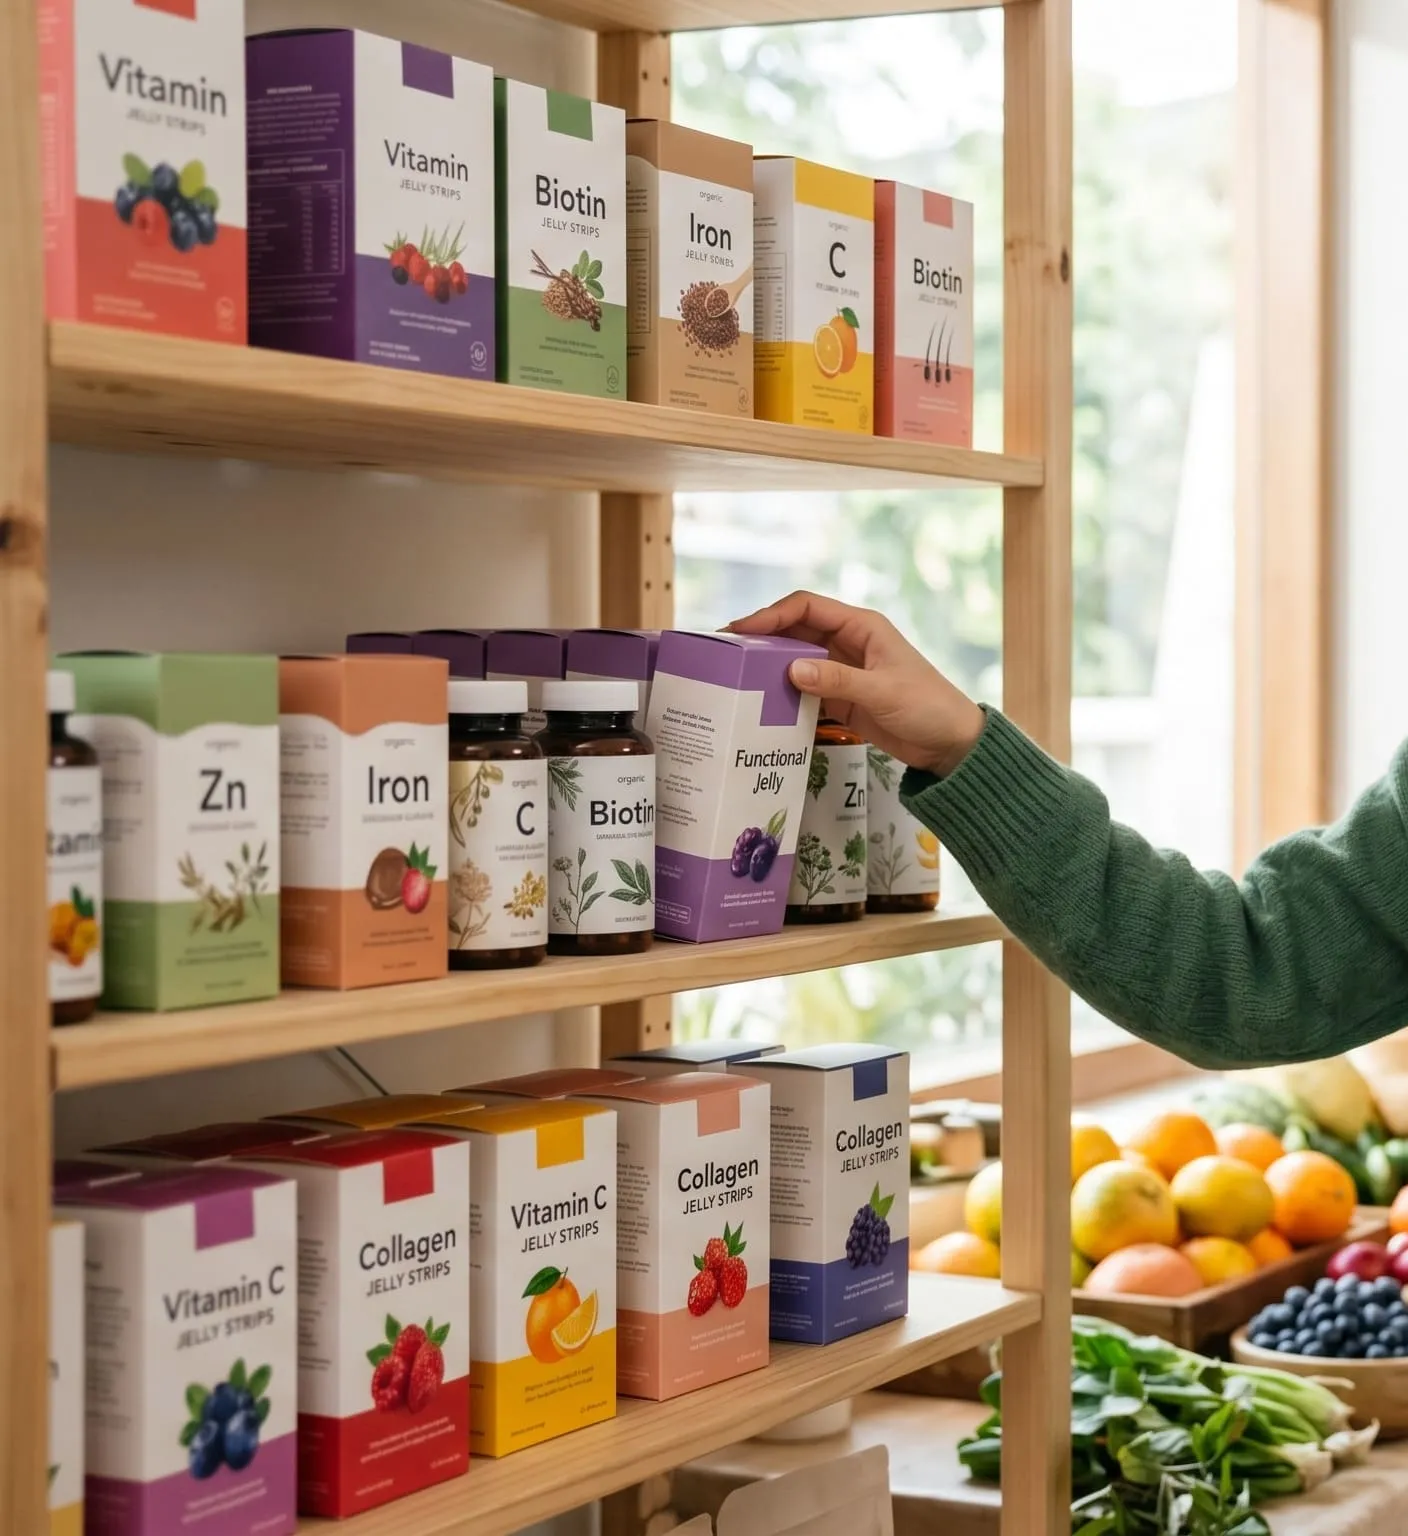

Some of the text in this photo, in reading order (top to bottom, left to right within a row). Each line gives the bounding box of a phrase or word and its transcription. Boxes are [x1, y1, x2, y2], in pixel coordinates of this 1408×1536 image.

[98, 51, 227, 117] Vitamin
[384, 139, 468, 182] Vitamin
[400, 179, 461, 201] JELLY STRIPS
[535, 174, 606, 219] Biotin
[541, 217, 600, 238] JELLY STRIPS
[690, 212, 732, 251] Iron
[685, 249, 708, 263] JELLY
[829, 241, 846, 279] C
[913, 257, 962, 294] Biotin
[735, 746, 808, 768] Functional
[199, 769, 247, 812] Zn
[368, 765, 429, 805] Iron
[617, 774, 646, 786] organic
[753, 771, 784, 795] Jelly
[844, 782, 865, 808] Zn
[516, 801, 535, 836] C
[590, 798, 654, 828] Biotin
[836, 1121, 902, 1152] Collagen
[678, 1159, 759, 1192] Collagen
[840, 1146, 899, 1173] JELLY STRIPS
[511, 1184, 607, 1229] Vitamin C
[683, 1186, 753, 1214] JELLY STRIPS
[359, 1229, 456, 1270] Collagen
[521, 1220, 599, 1253] JELLY STRIPS
[162, 1265, 285, 1323] Vitamin C
[366, 1260, 450, 1298] JELLY STRIPS
[176, 1307, 274, 1350] JELLY STRIPS
